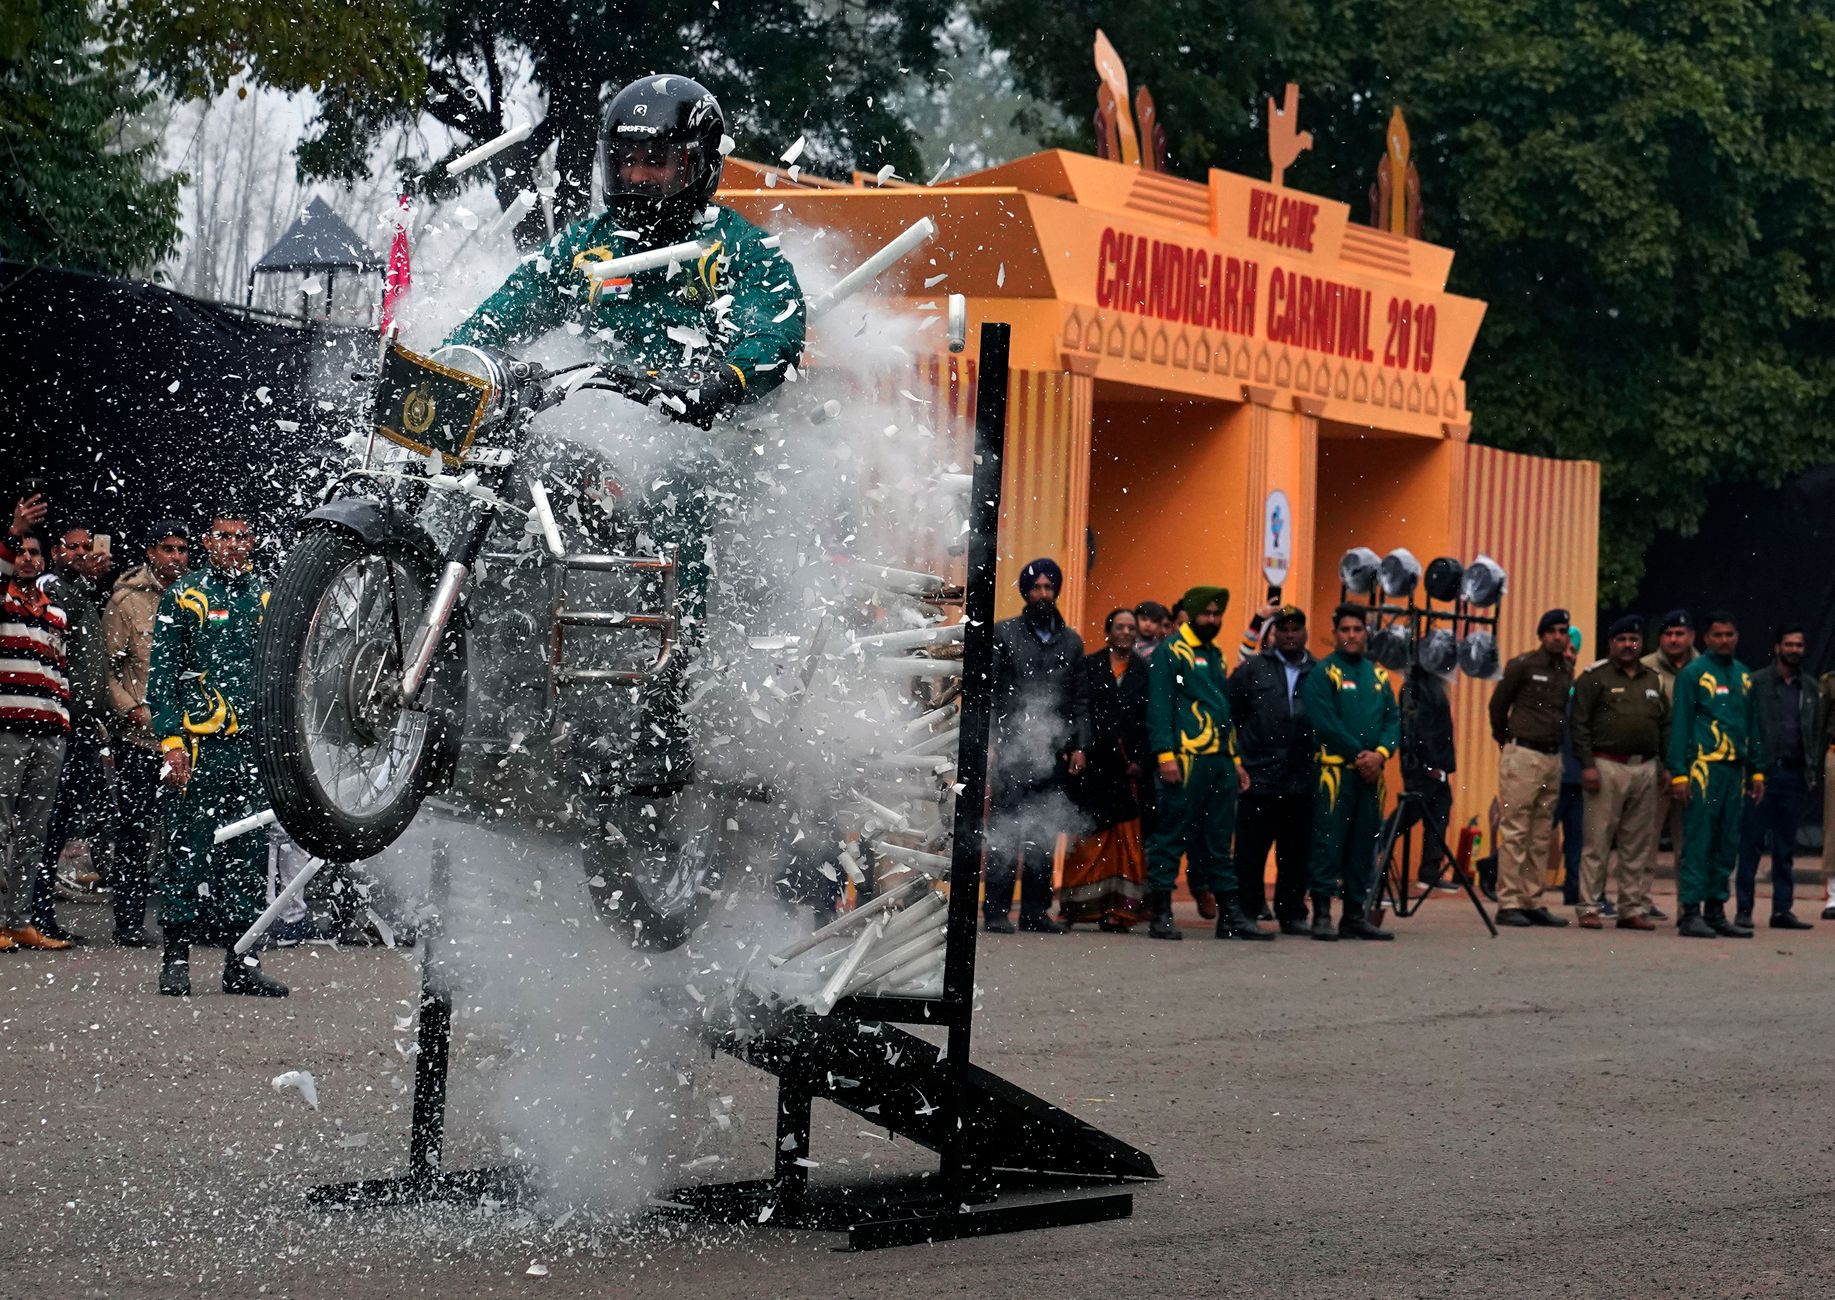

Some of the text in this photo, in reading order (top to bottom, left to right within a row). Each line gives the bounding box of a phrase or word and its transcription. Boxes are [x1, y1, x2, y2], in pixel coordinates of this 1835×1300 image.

[1248, 188, 1319, 253] WELCOME
[1096, 227, 1436, 374] CHANDIGARH CARNIVAL 2019
